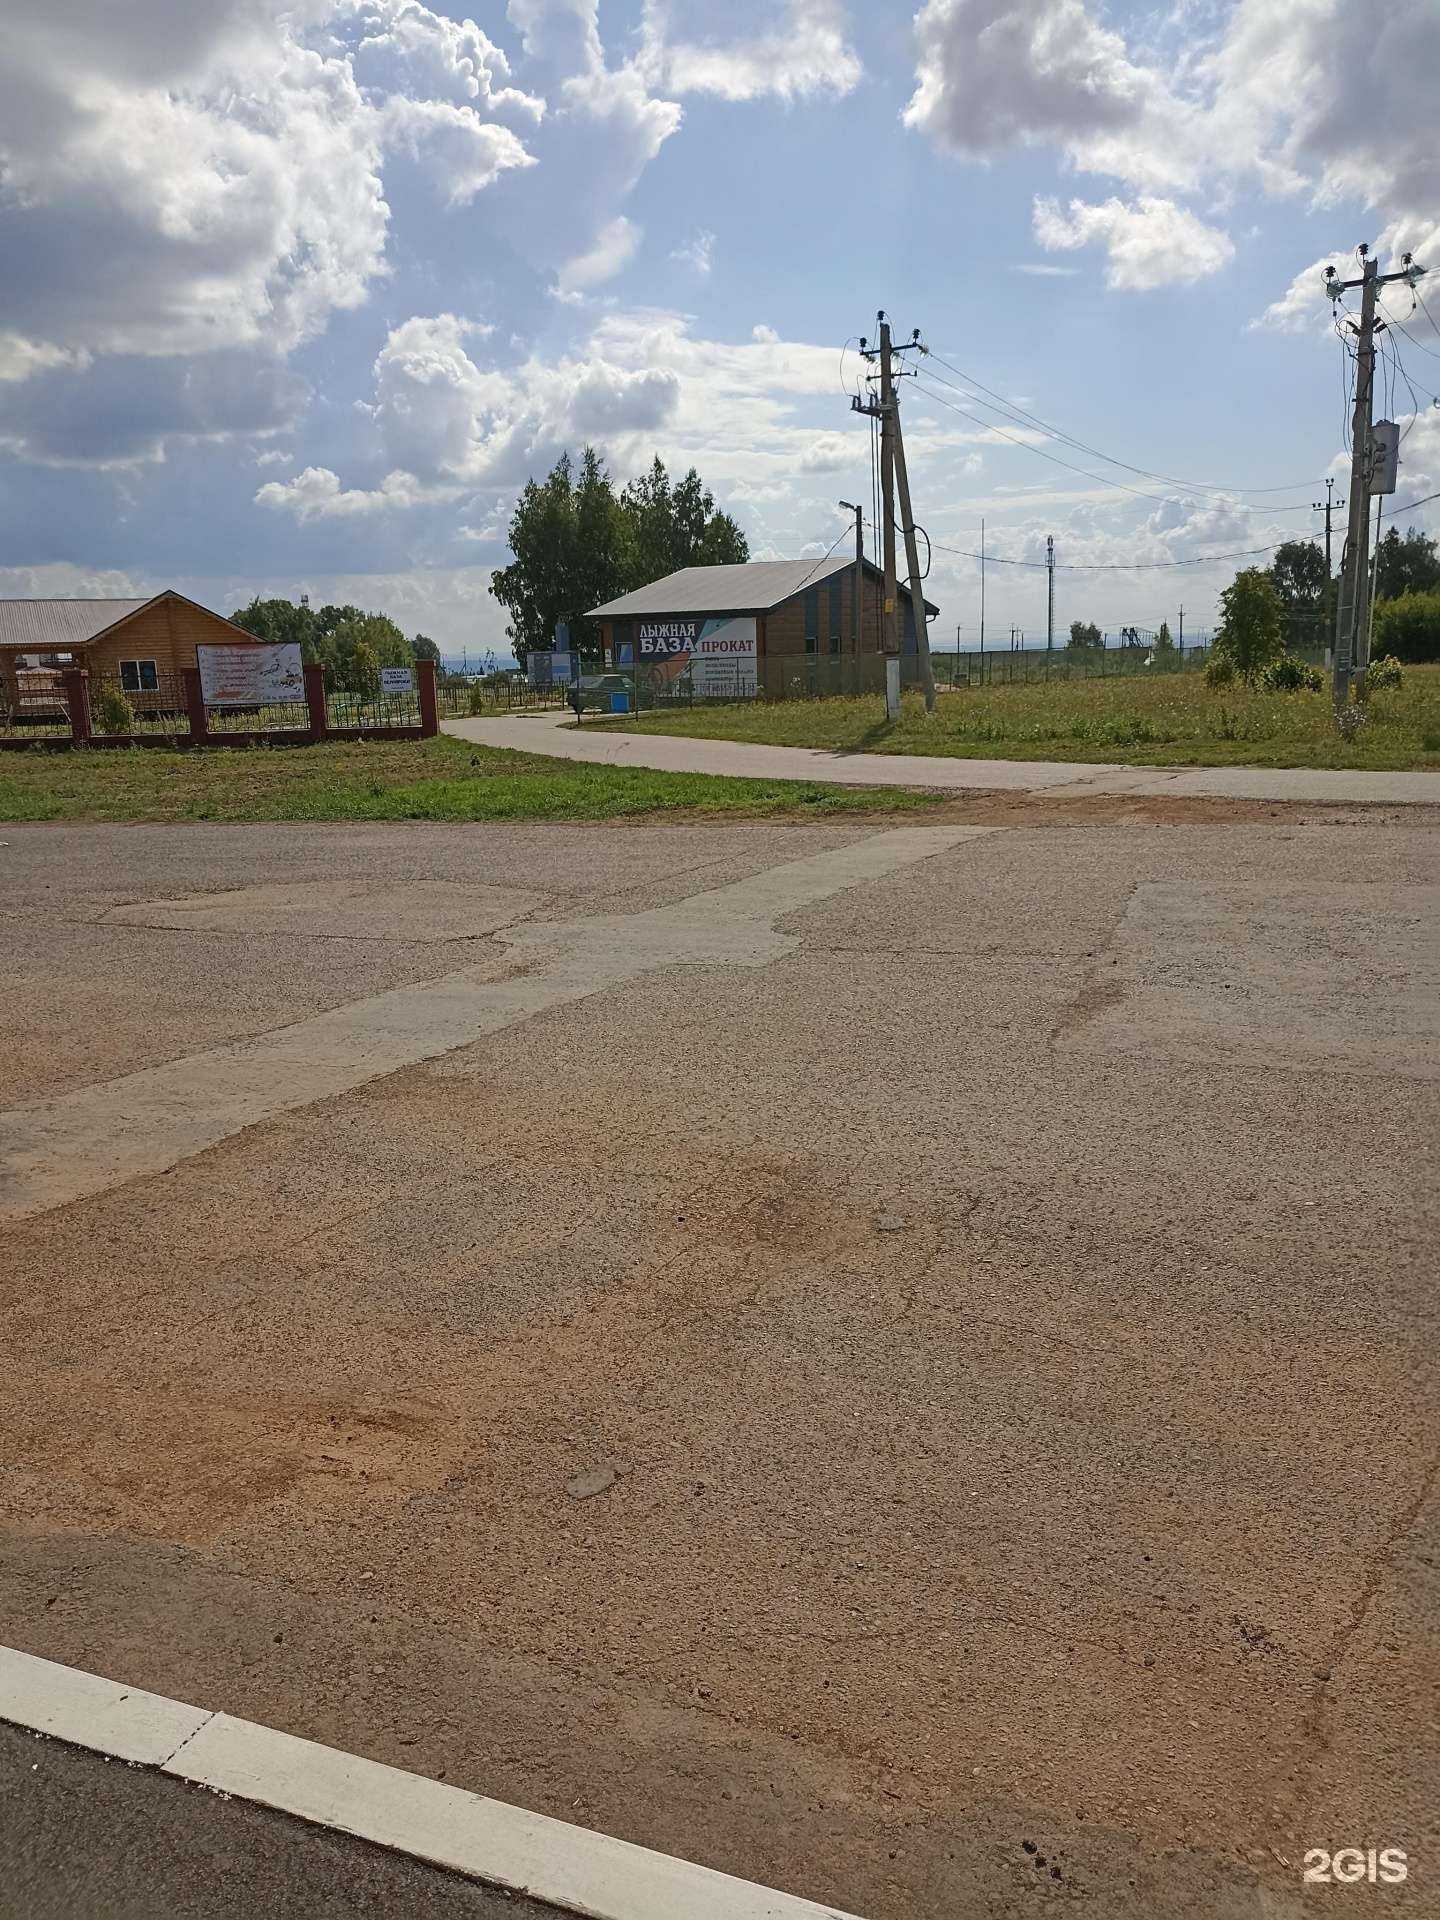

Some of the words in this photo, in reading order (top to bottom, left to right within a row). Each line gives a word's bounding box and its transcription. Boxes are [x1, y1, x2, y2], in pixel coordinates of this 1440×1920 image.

[639, 623, 696, 638] ЛЫЖНАЯ
[640, 637, 697, 653] БАЗА
[701, 640, 754, 653] ПРОКАТ
